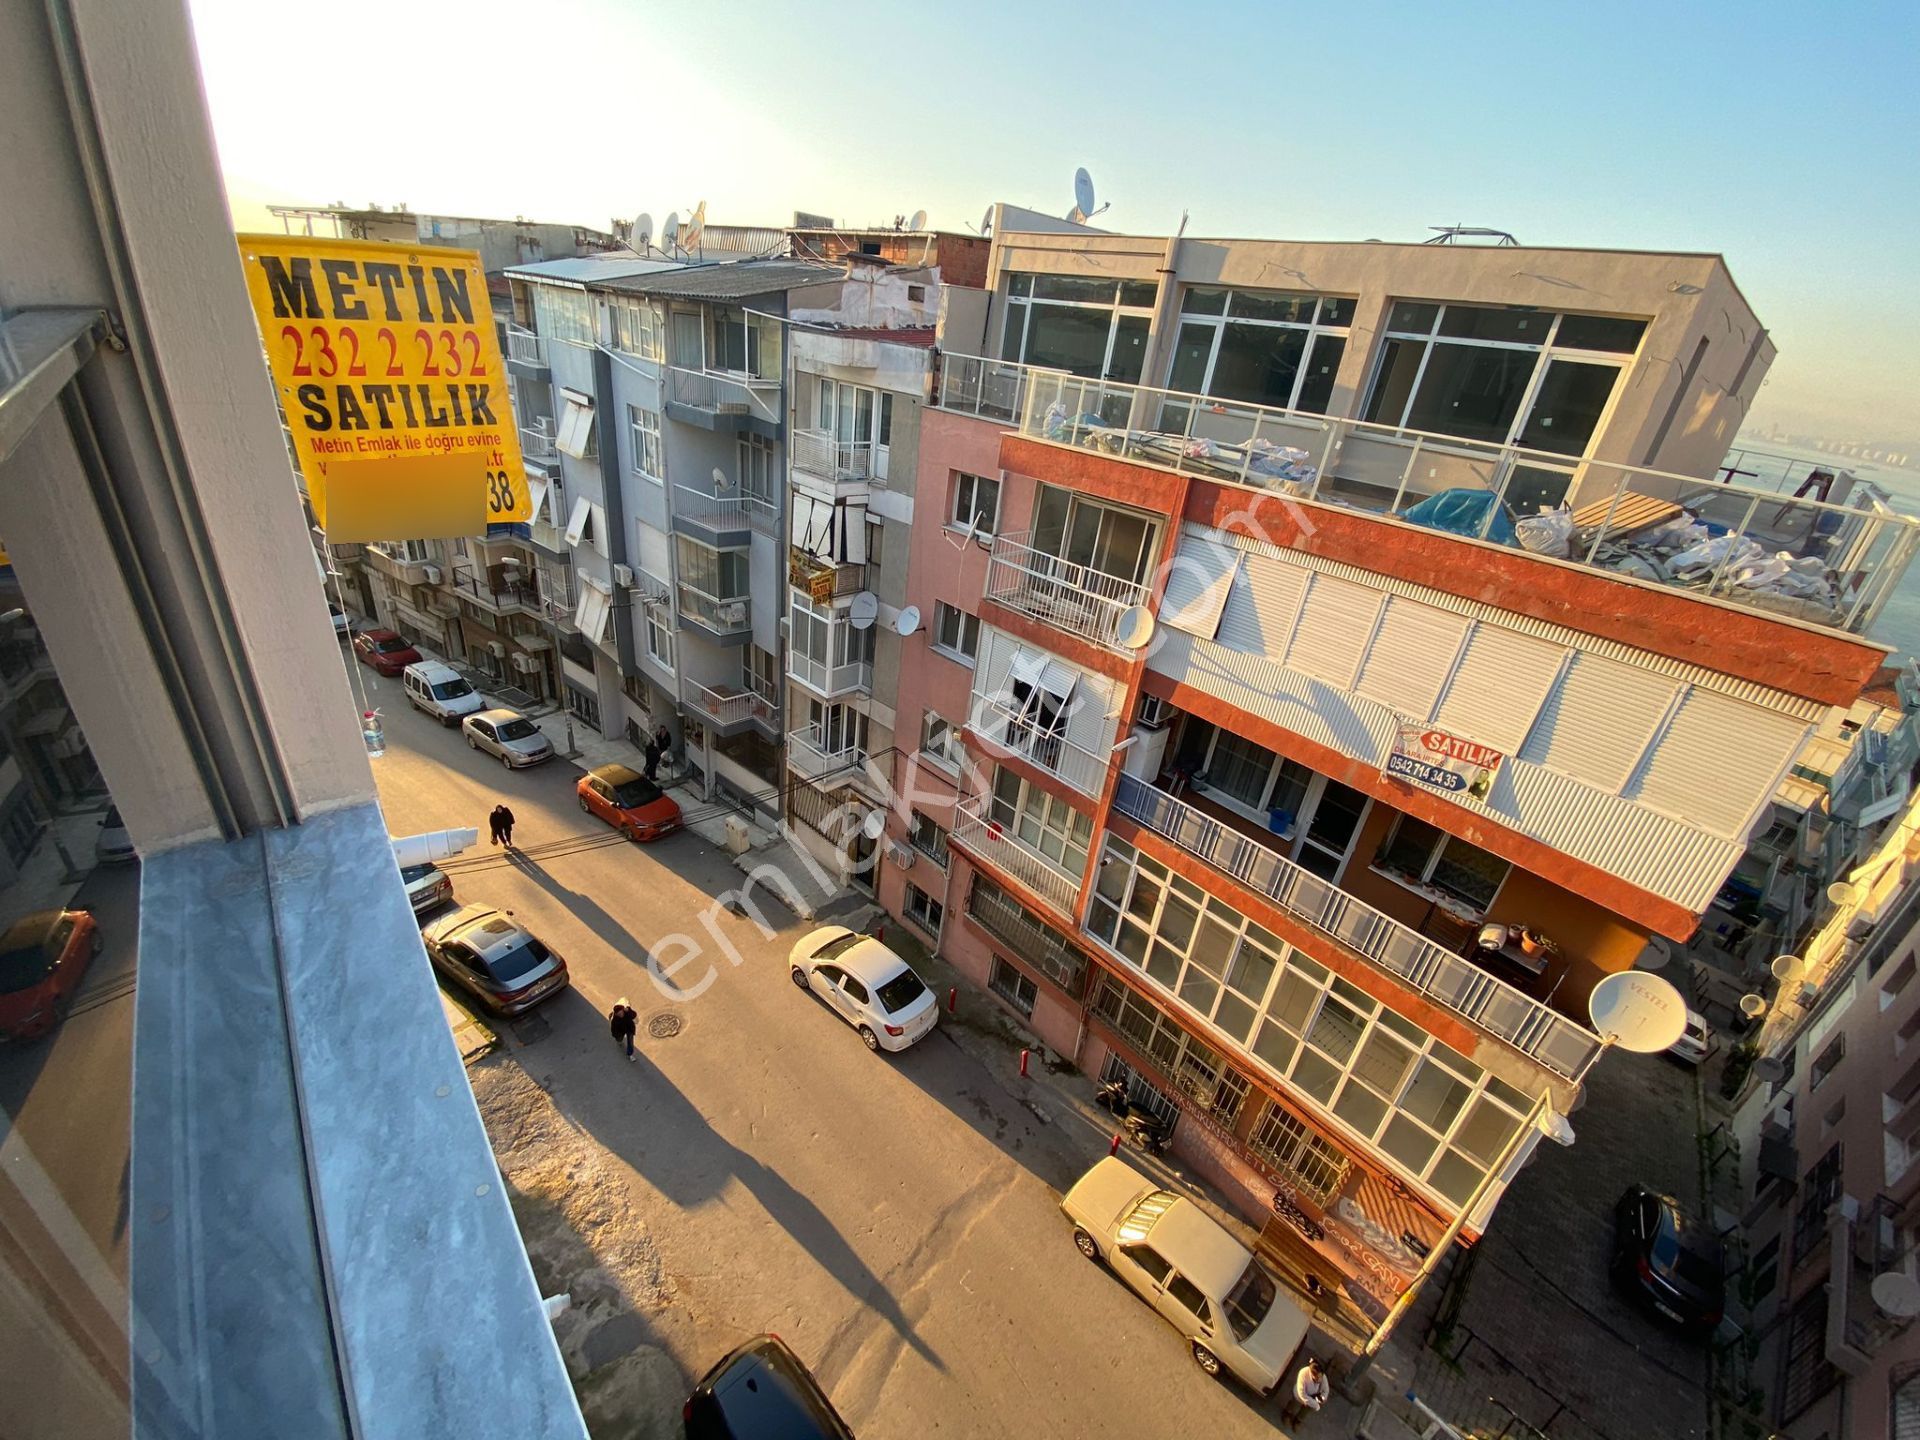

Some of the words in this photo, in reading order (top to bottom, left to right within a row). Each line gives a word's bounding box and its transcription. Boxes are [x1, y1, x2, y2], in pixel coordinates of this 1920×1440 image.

[281, 325, 367, 378] 232
[377, 327, 404, 377] 2
[414, 328, 487, 377] 232
[297, 383, 498, 432] SATILIK
[310, 437, 353, 454] Metin
[358, 434, 402, 452] Emlak
[404, 433, 422, 450] ile
[424, 432, 464, 451] doğru
[467, 434, 501, 447] evine
[1428, 733, 1500, 769] SATILIK
[1389, 756, 1412, 774] 0542
[1412, 762, 1430, 780] 714
[1430, 769, 1444, 784] 34
[1443, 773, 1458, 788] 35
[1630, 982, 1668, 1011] VESTEL
